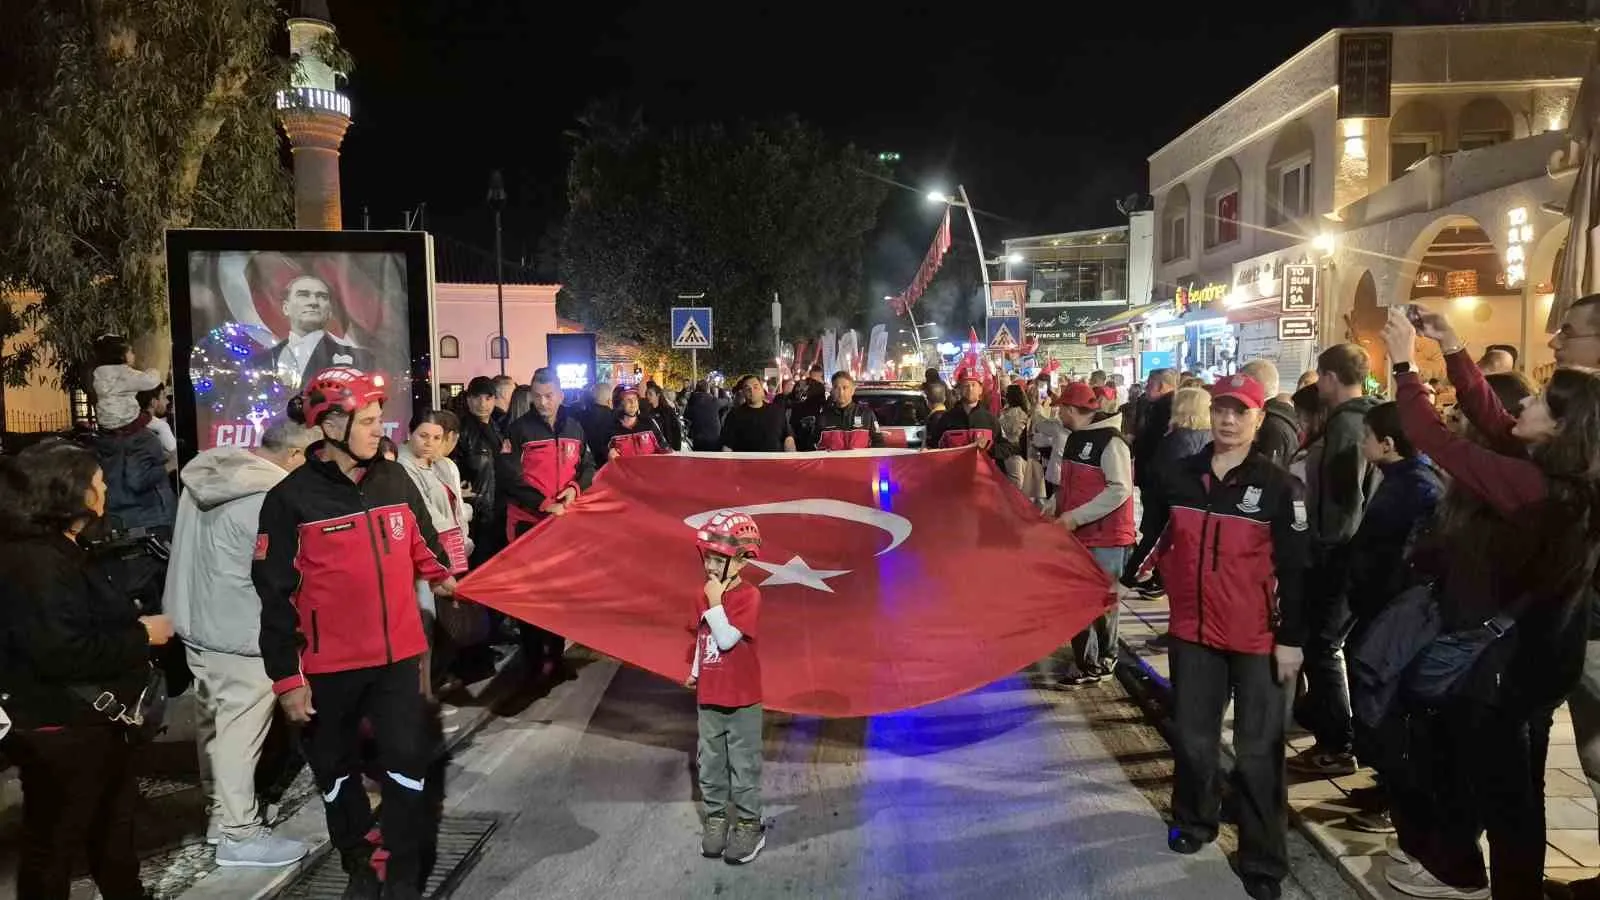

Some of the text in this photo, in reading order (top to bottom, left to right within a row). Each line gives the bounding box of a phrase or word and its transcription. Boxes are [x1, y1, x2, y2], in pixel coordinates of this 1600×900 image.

[1291, 267, 1305, 276] TO
[1290, 277, 1310, 285] SUN
[1290, 286, 1304, 294] PA
